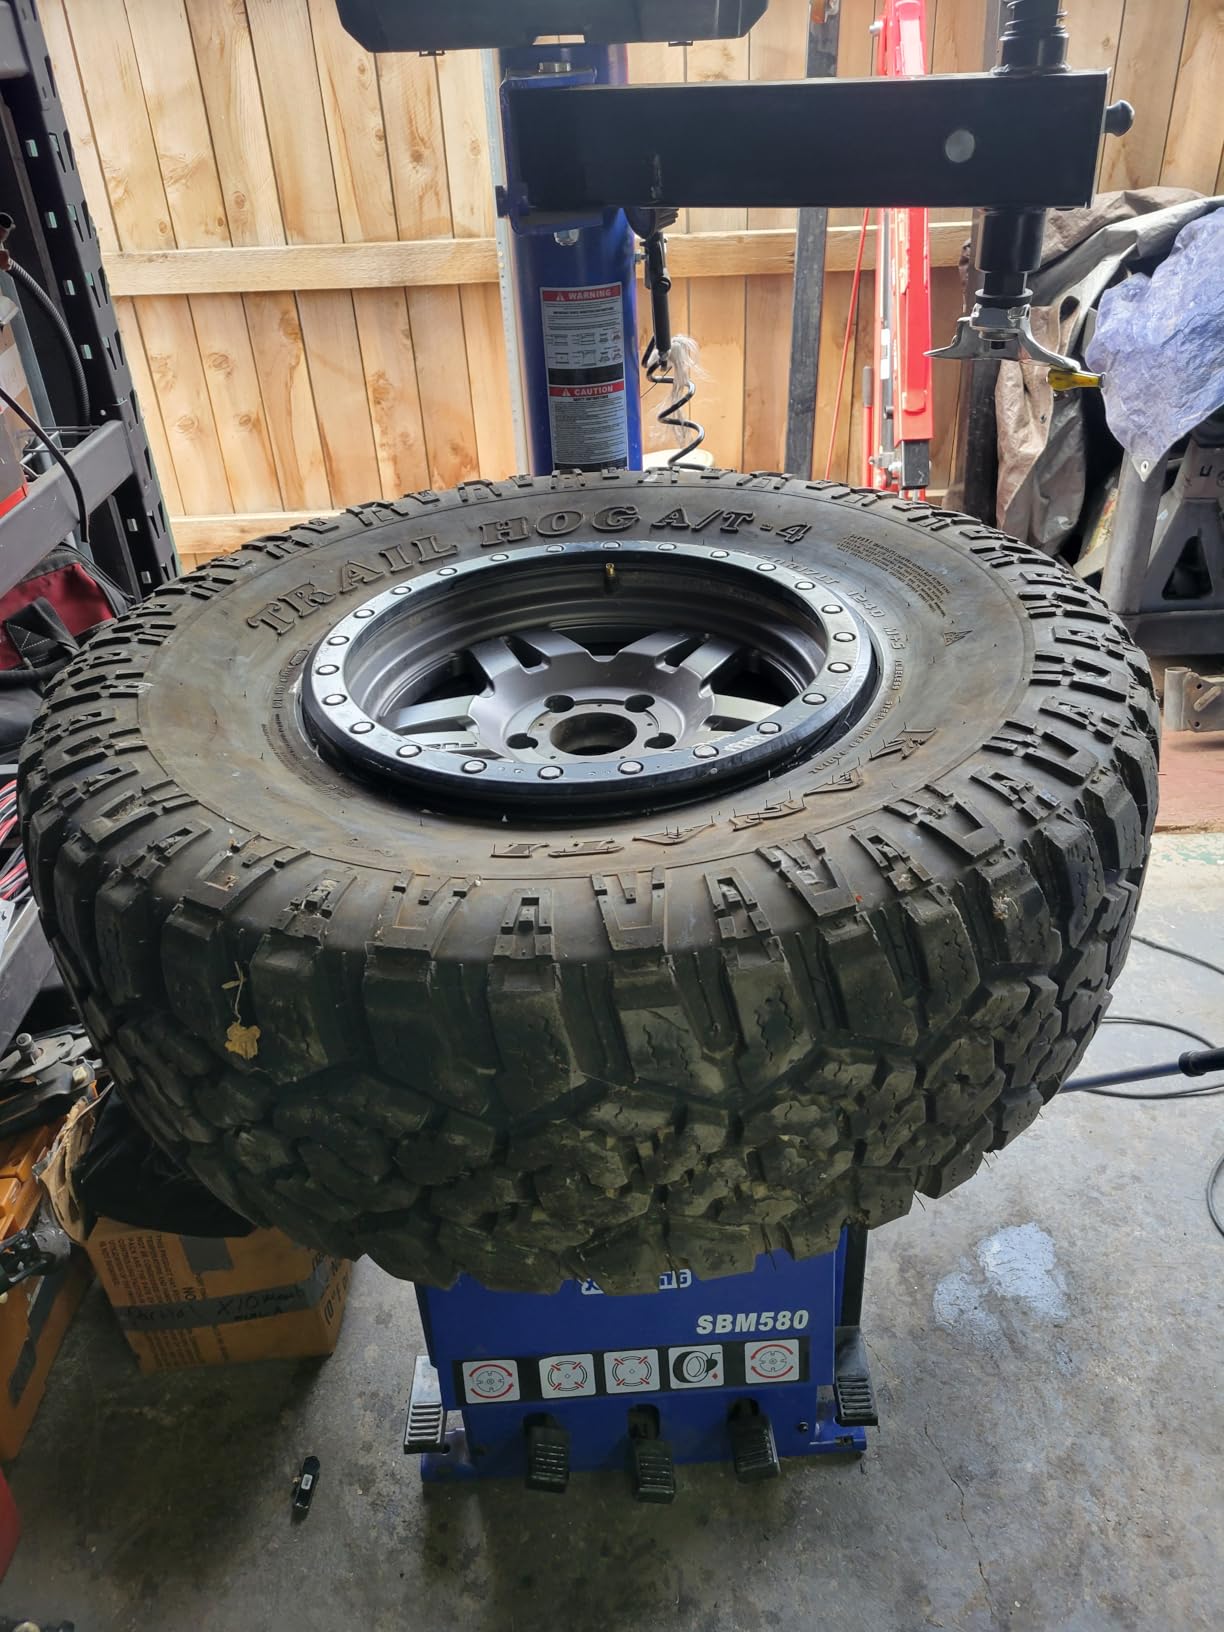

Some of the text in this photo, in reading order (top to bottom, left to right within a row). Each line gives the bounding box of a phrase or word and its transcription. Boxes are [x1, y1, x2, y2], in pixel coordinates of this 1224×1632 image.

[568, 289, 612, 300] WARNING
[574, 385, 614, 396] CAUTION
[248, 505, 813, 636] TRAIL HOG A/T-4
[696, 1310, 809, 1335] SBM580
